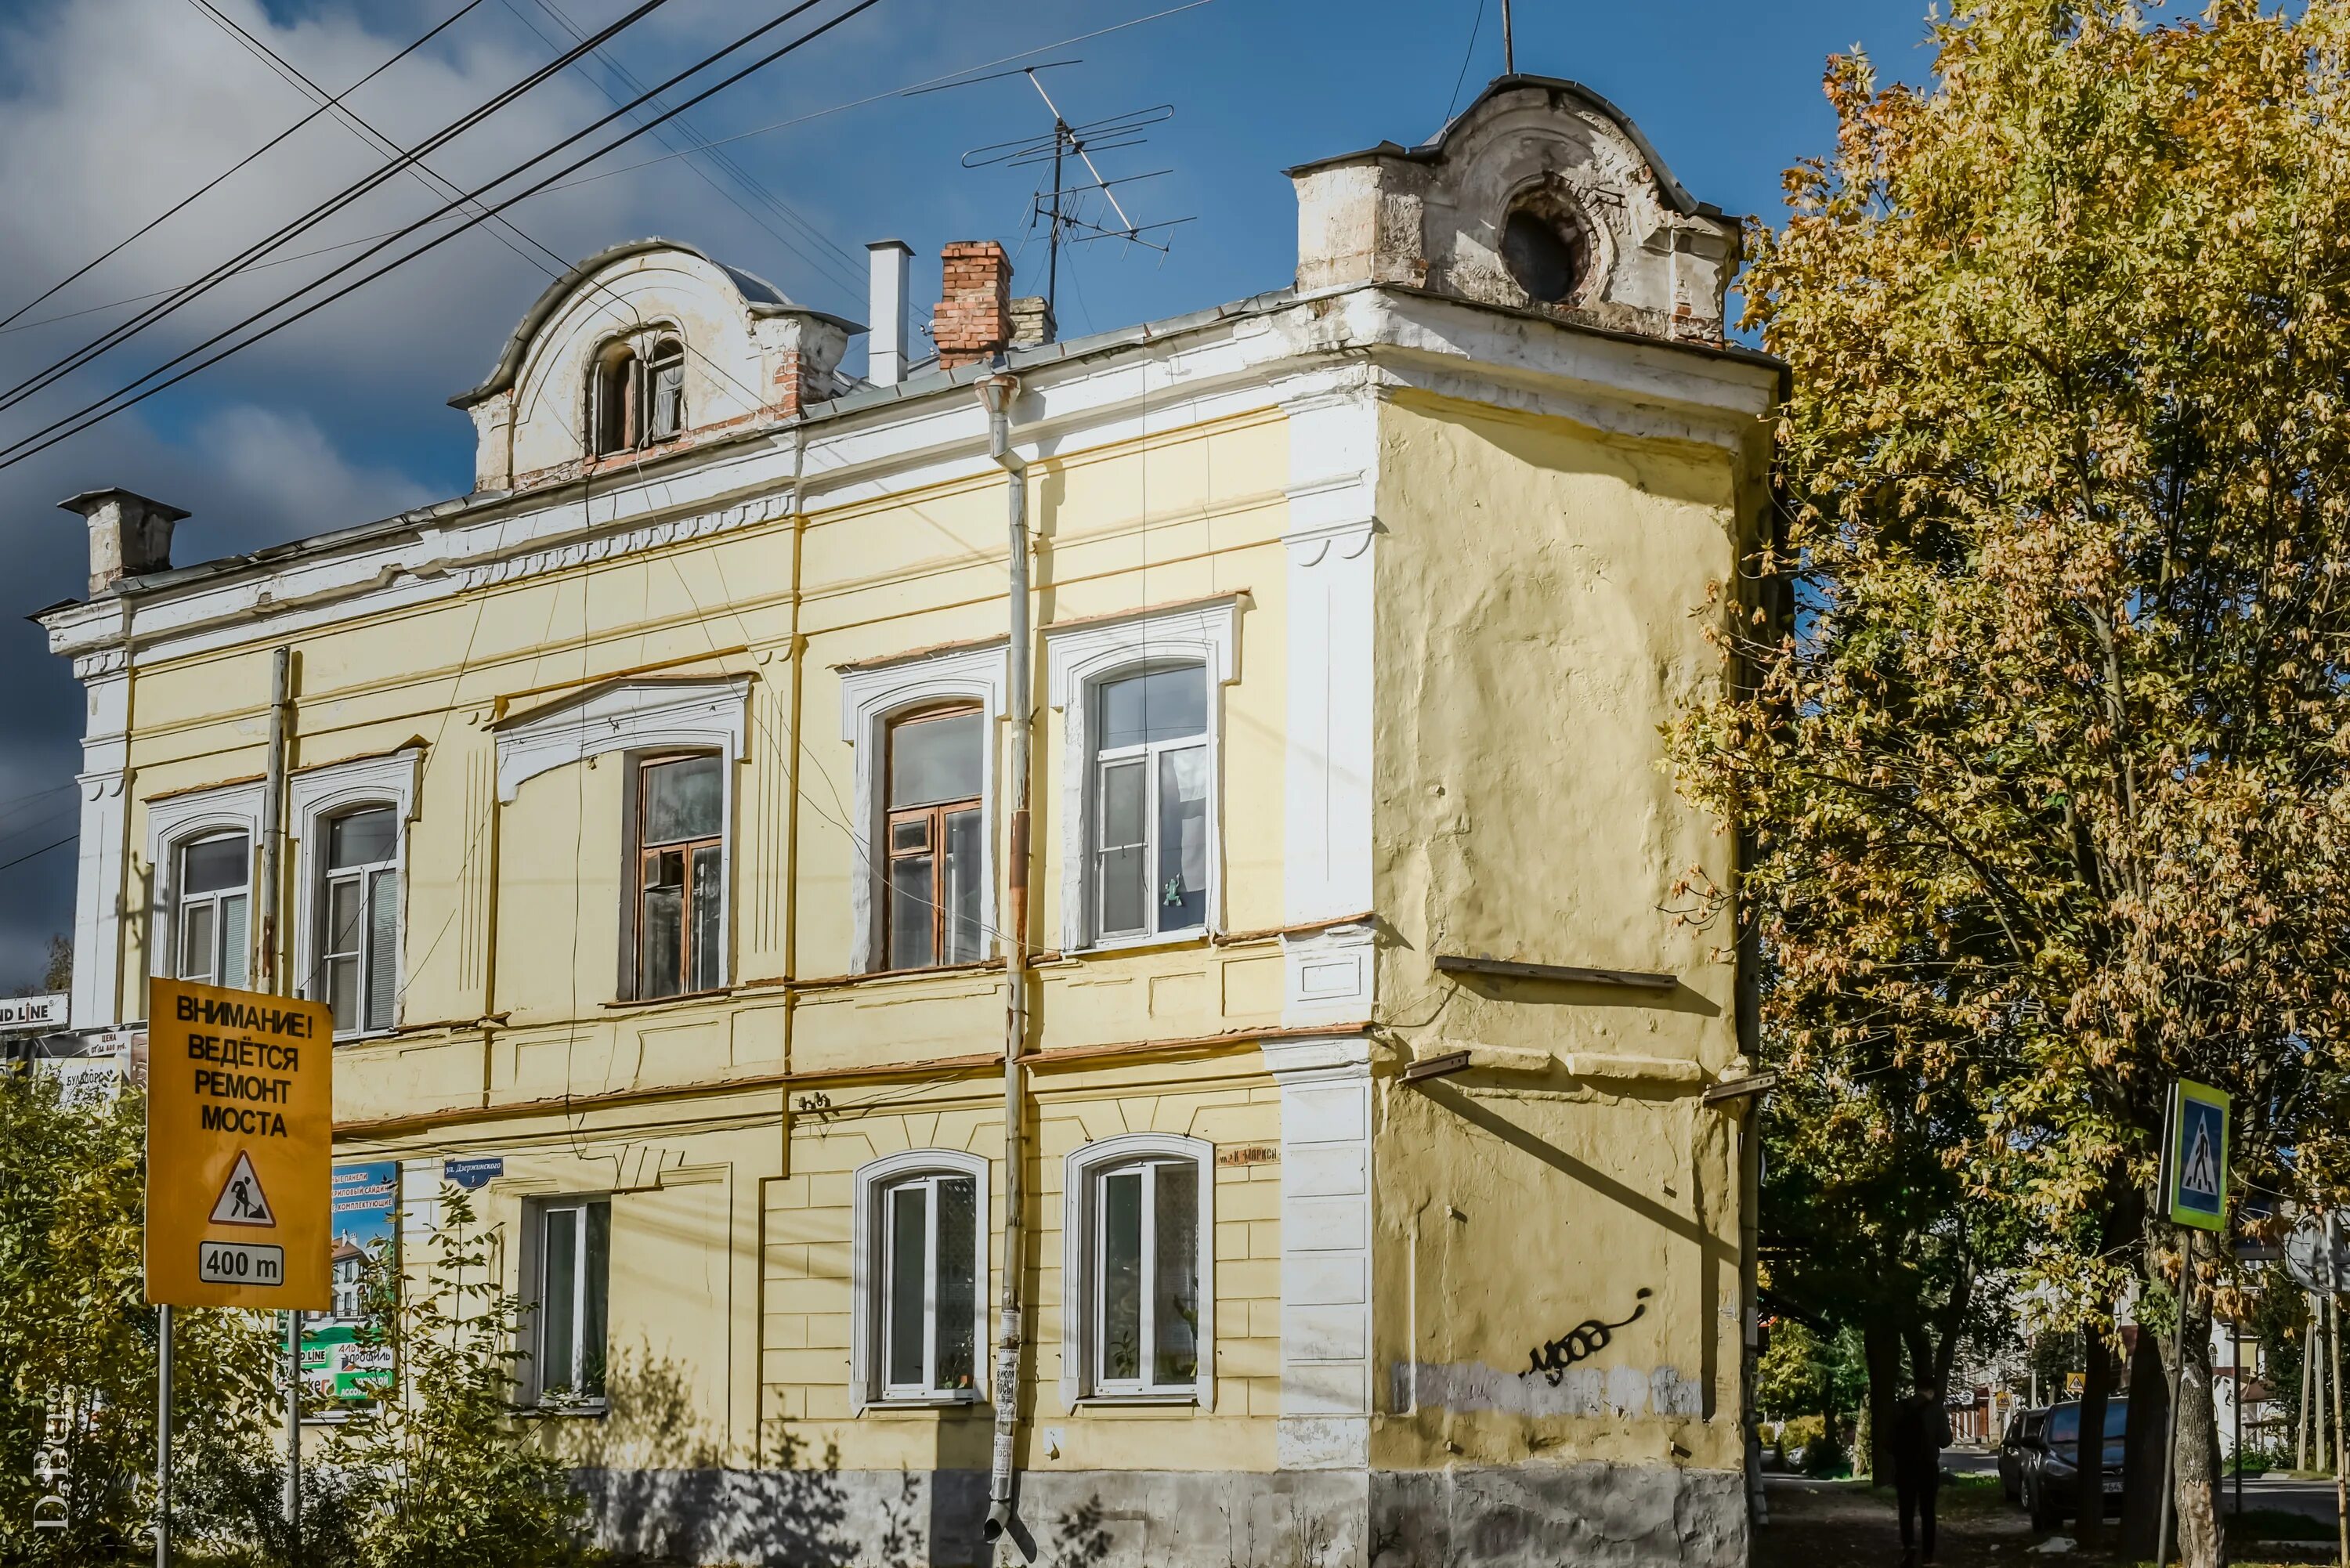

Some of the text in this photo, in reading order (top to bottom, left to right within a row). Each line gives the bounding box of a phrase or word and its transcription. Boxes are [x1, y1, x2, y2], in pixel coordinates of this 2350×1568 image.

[18, 1002, 48, 1021] LINE
[177, 995, 313, 1039] ВНИМАНИЕ!
[102, 1033, 117, 1043] ЦЕНА
[188, 1033, 298, 1072] ВЕДЁТСЯ
[194, 1069, 291, 1104] РЕМОНТ
[201, 1104, 287, 1138] МОСТА
[446, 1162, 501, 1175] ул. Дзержинского
[338, 1198, 392, 1210] КОМПЛЕКТУЮЩИЕ
[206, 1249, 277, 1278] 400 m
[308, 1349, 326, 1362] LINE
